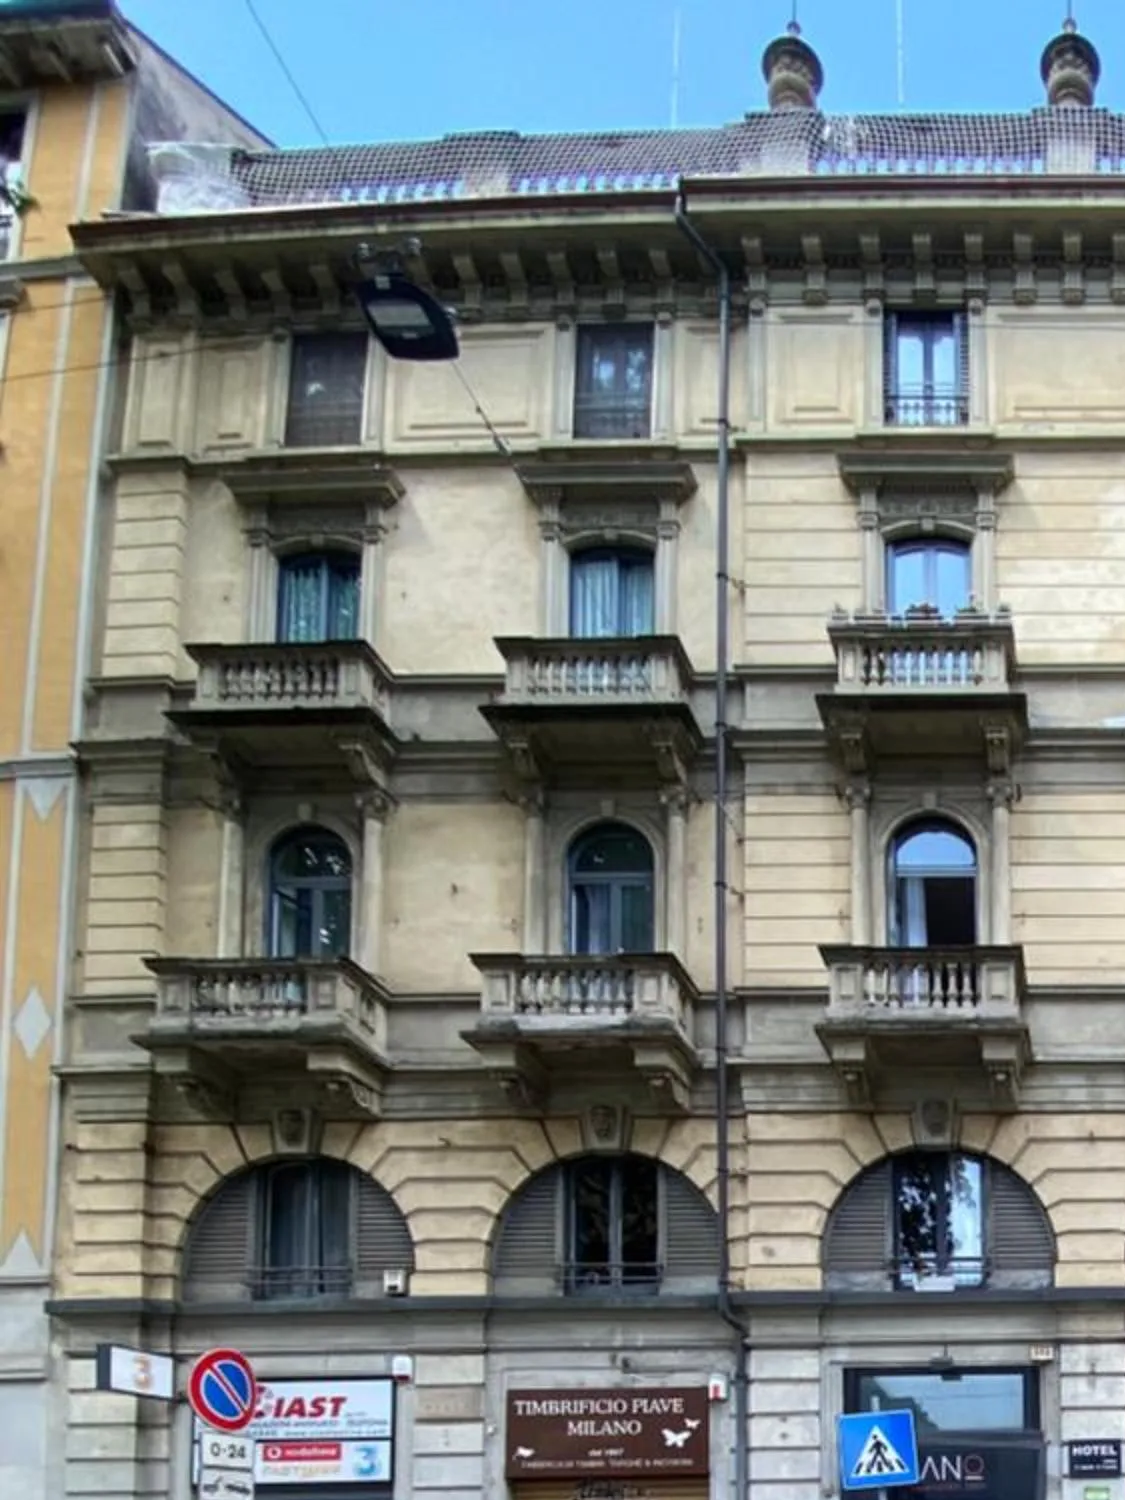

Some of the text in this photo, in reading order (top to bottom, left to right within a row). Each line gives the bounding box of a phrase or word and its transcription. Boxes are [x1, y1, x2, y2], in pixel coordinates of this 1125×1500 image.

[514, 1398, 684, 1416] TIMBRIFICIO PIAVE
[567, 1420, 642, 1437] MILANO
[1072, 1444, 1118, 1457] HOTEL
[352, 1447, 381, 1477] 3
